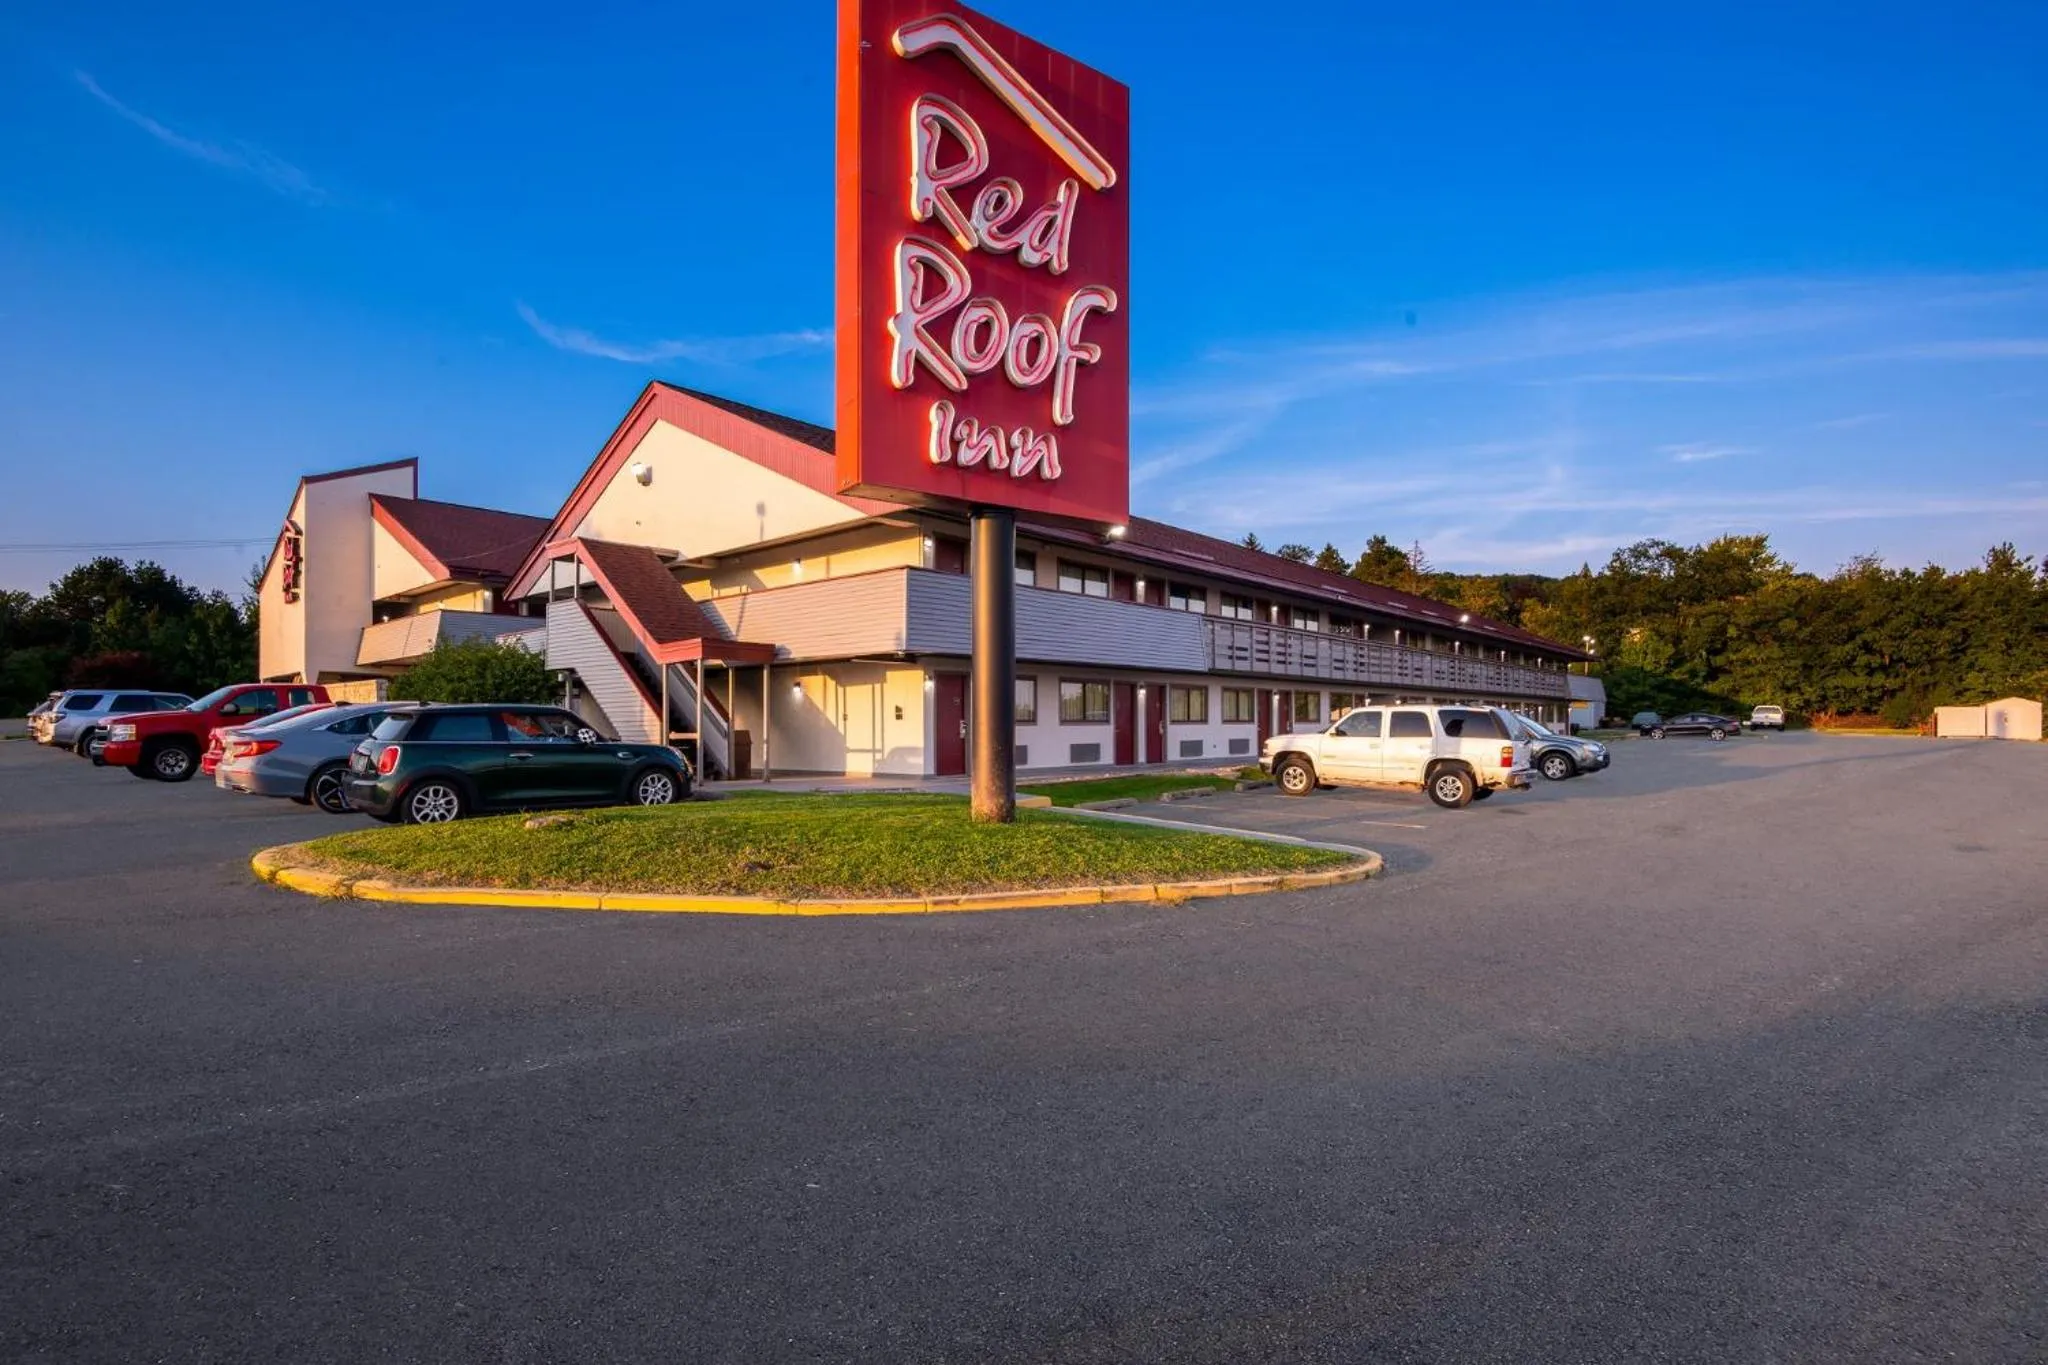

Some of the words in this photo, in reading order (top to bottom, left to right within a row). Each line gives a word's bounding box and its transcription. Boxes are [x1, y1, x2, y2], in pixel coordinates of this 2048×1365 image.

[910, 95, 1079, 275] Red
[888, 236, 1117, 425] Roof
[930, 401, 1062, 480] Inn
